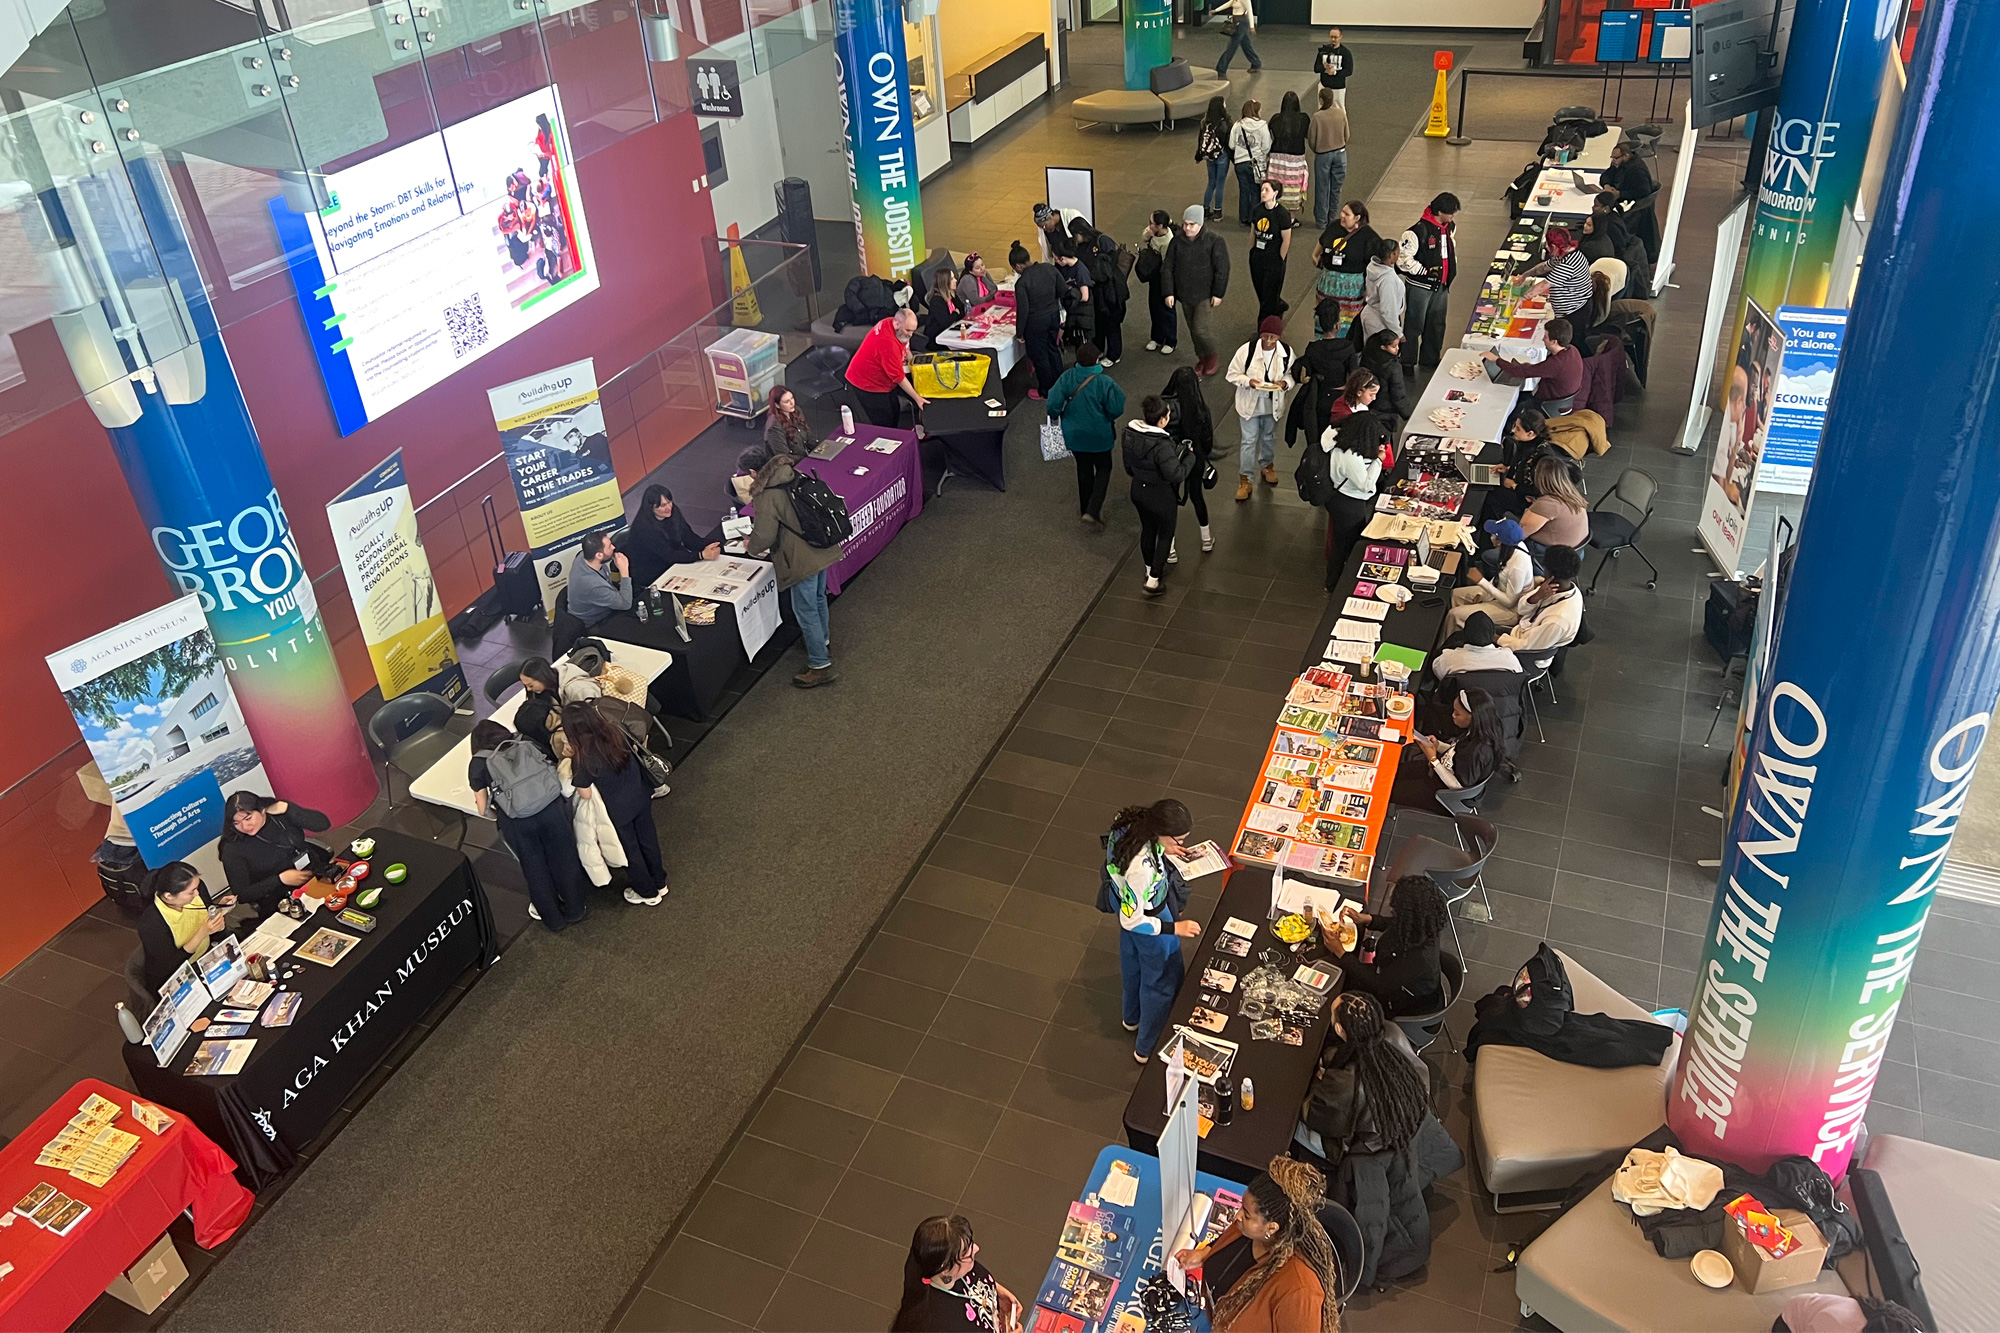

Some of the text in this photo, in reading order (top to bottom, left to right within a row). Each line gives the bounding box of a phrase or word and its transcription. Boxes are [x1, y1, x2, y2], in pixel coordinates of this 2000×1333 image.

[701, 102, 731, 112] Washrooms
[868, 52, 902, 141] OWN
[879, 146, 907, 192] THE
[325, 177, 446, 237] eyond the Storm: DBT Skills for
[329, 181, 475, 253] Navigating Emotions and Relationhips
[883, 196, 915, 278] JOBSITE
[1792, 327, 1837, 339] You are
[515, 449, 546, 466] START
[517, 461, 547, 477] YOUR
[520, 468, 559, 487] CAREER
[522, 467, 594, 498] IN THE TRADES
[849, 477, 907, 541] AREER FOUNDATION
[1725, 512, 1738, 535] Join
[355, 530, 385, 562] SOCIALLY
[360, 539, 408, 583] PROFESSIONAL
[363, 549, 409, 594] RENOVATIONS
[90, 615, 189, 664] AGA KHAN MUSEUM
[1737, 682, 1828, 889] OWN
[1887, 712, 1990, 905] OWN
[150, 797, 207, 833] Connecting Cultures
[153, 808, 201, 839] Through the Arts
[1716, 875, 1782, 983] THE
[1859, 905, 1931, 1004] THE
[283, 1055, 330, 1110] AGA
[330, 980, 393, 1054] KHAN
[1681, 959, 1758, 1140] SERVICE
[1811, 1000, 1900, 1163] SERVICE
[1066, 1266, 1079, 1291] OPEN
